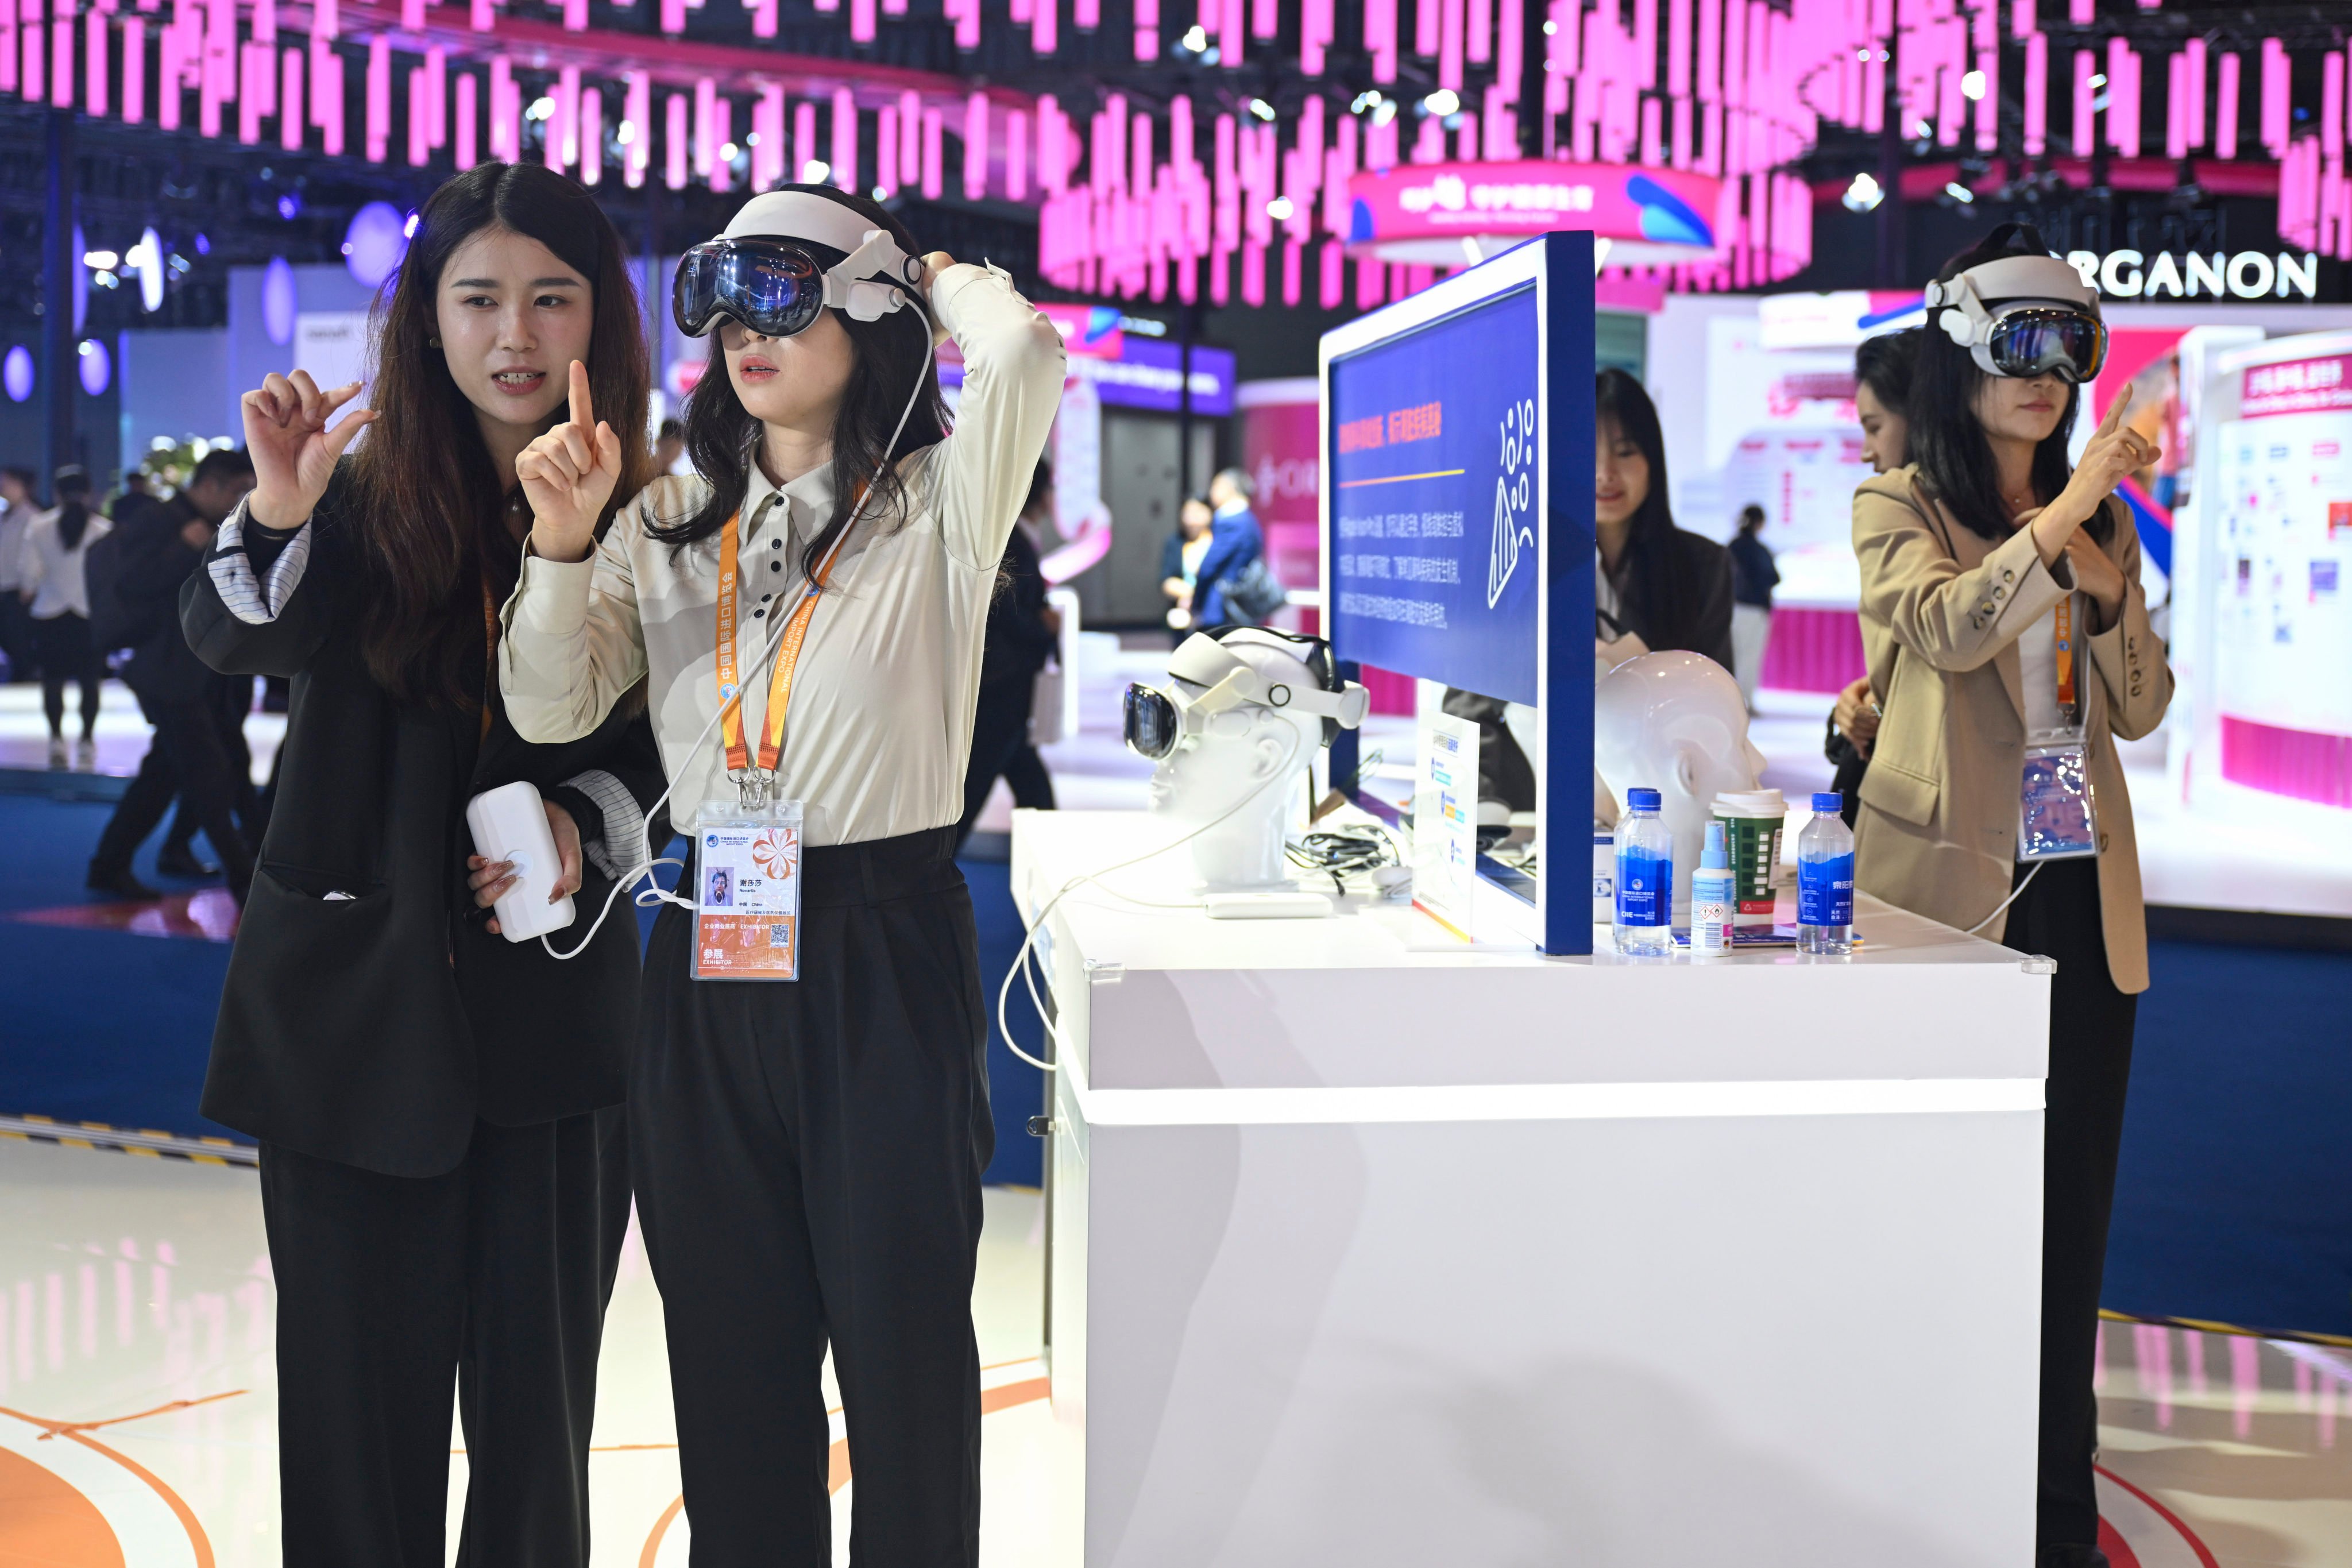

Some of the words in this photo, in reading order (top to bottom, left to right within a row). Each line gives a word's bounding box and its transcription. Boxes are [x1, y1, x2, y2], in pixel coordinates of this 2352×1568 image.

[2049, 249, 2318, 299] RGANON
[720, 571, 733, 679] 中国国际进口博览会
[799, 601, 813, 625] CHINA
[785, 617, 800, 648] IMPORT
[778, 650, 790, 673] EXPO
[781, 627, 804, 693] INTERNATIONAL
[740, 879, 762, 887] 谢莎莎
[703, 948, 724, 959] 参展
